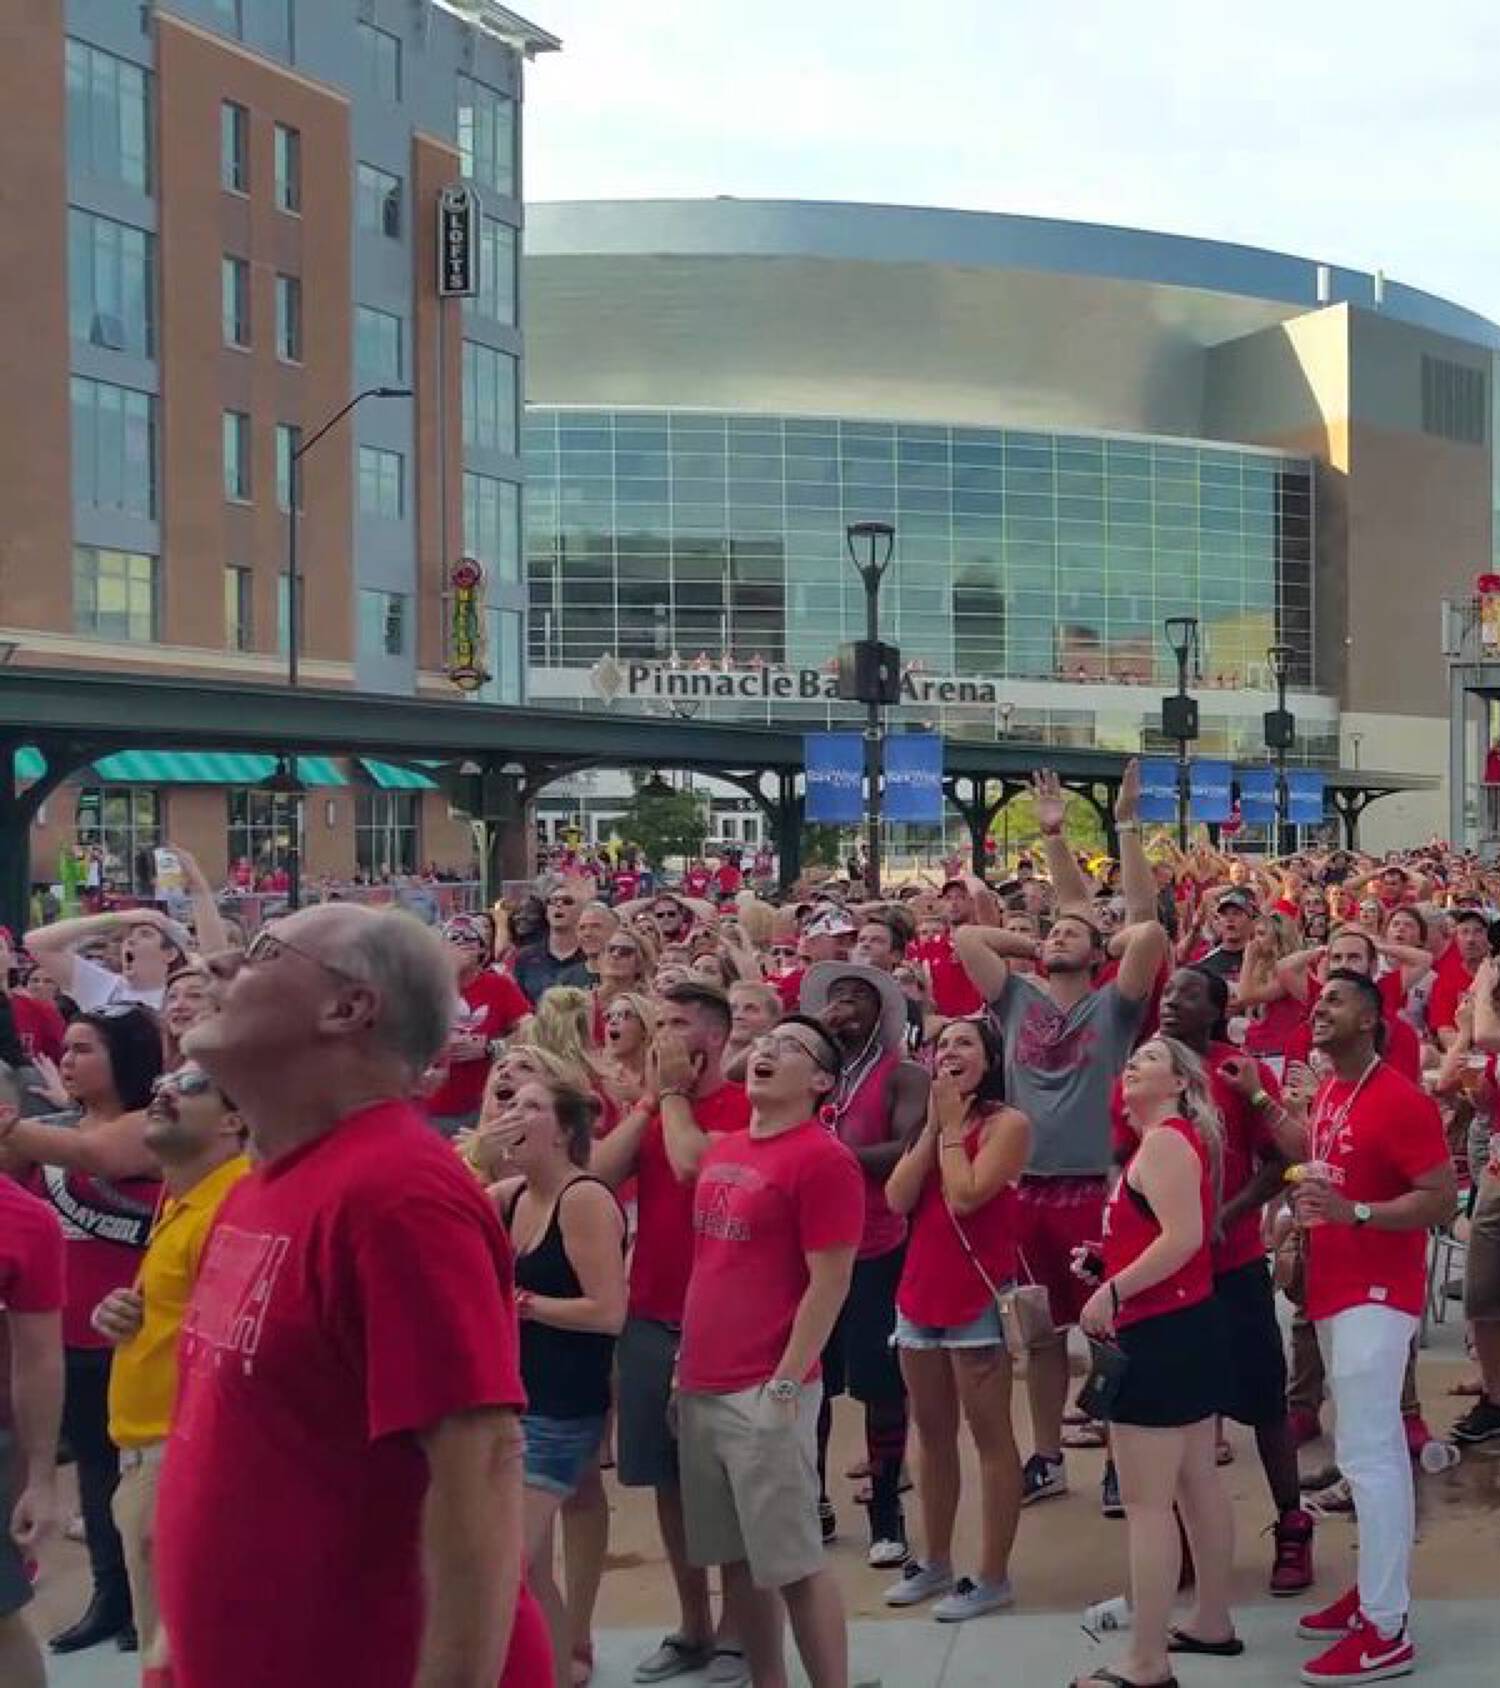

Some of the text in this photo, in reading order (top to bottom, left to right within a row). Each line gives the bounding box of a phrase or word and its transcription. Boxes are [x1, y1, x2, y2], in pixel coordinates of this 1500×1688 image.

[449, 213, 464, 289] LOFTS
[628, 665, 793, 699] Pinnacle
[900, 671, 997, 702] Arena
